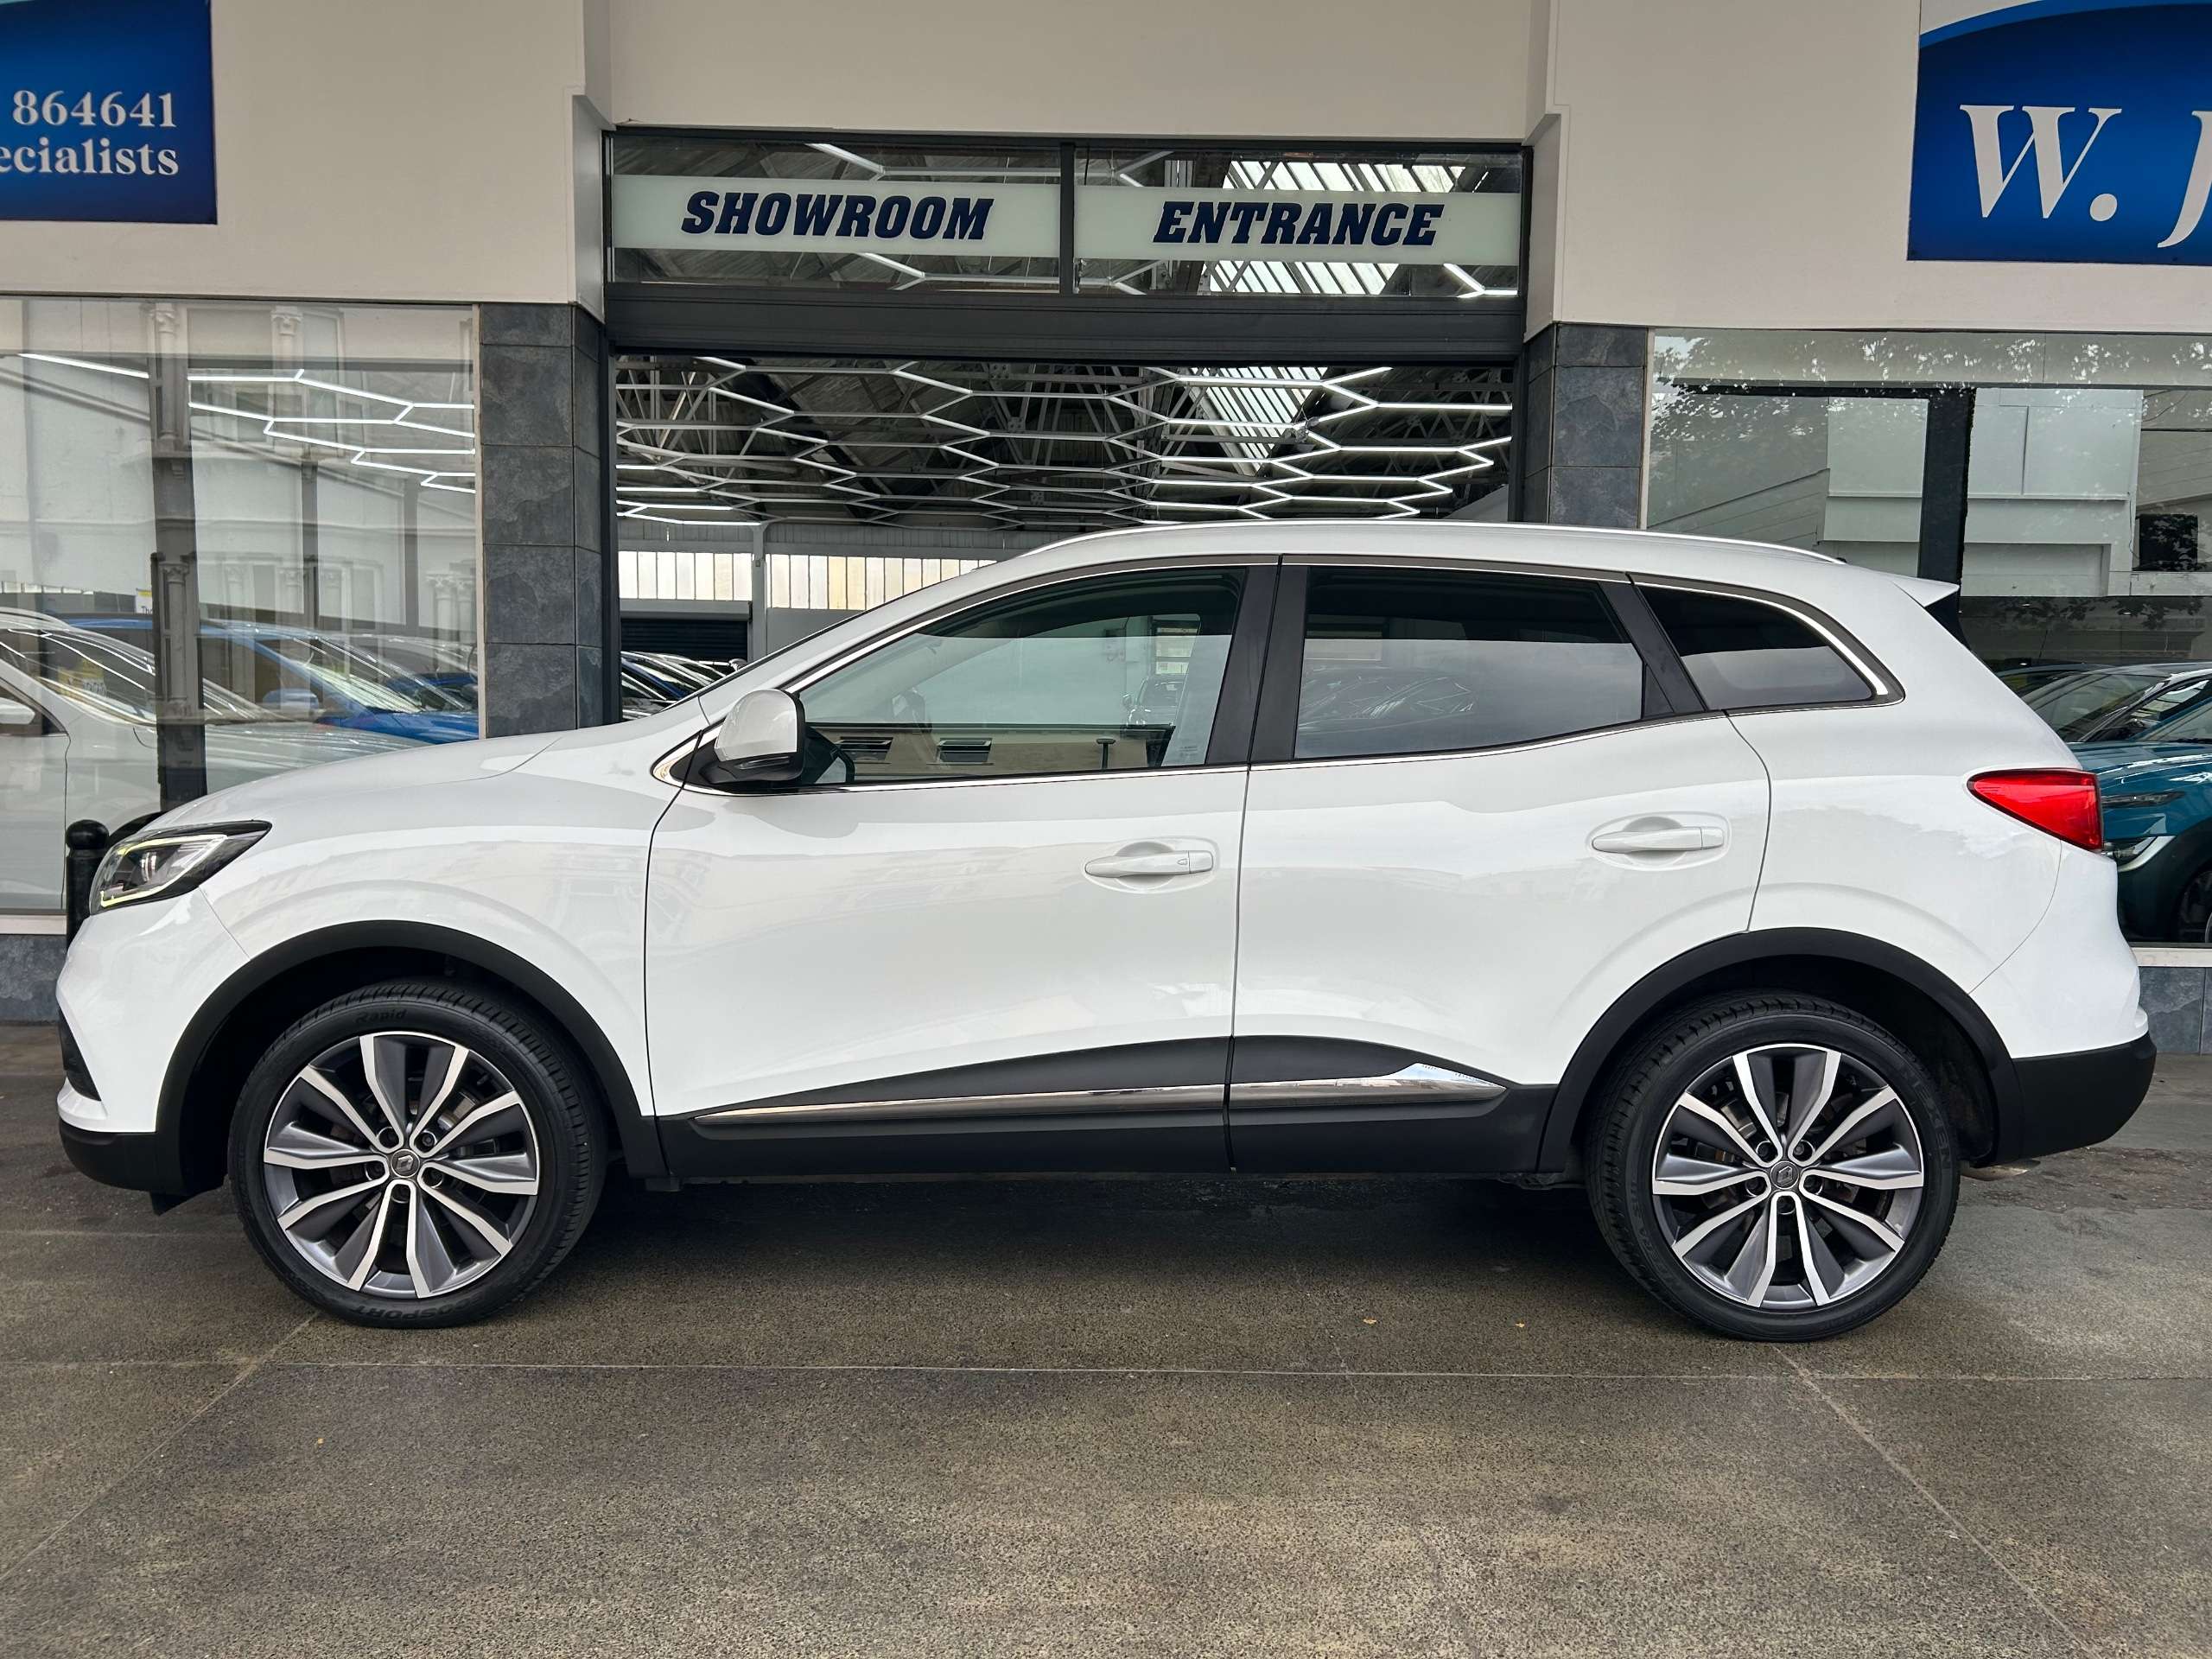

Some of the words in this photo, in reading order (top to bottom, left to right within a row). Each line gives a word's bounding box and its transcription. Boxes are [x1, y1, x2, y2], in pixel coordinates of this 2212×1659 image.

[13, 90, 176, 127] 864641
[1960, 105, 2122, 221] W.
[681, 191, 995, 240] SHOWROOM
[1154, 200, 1445, 245] ENTRANCE
